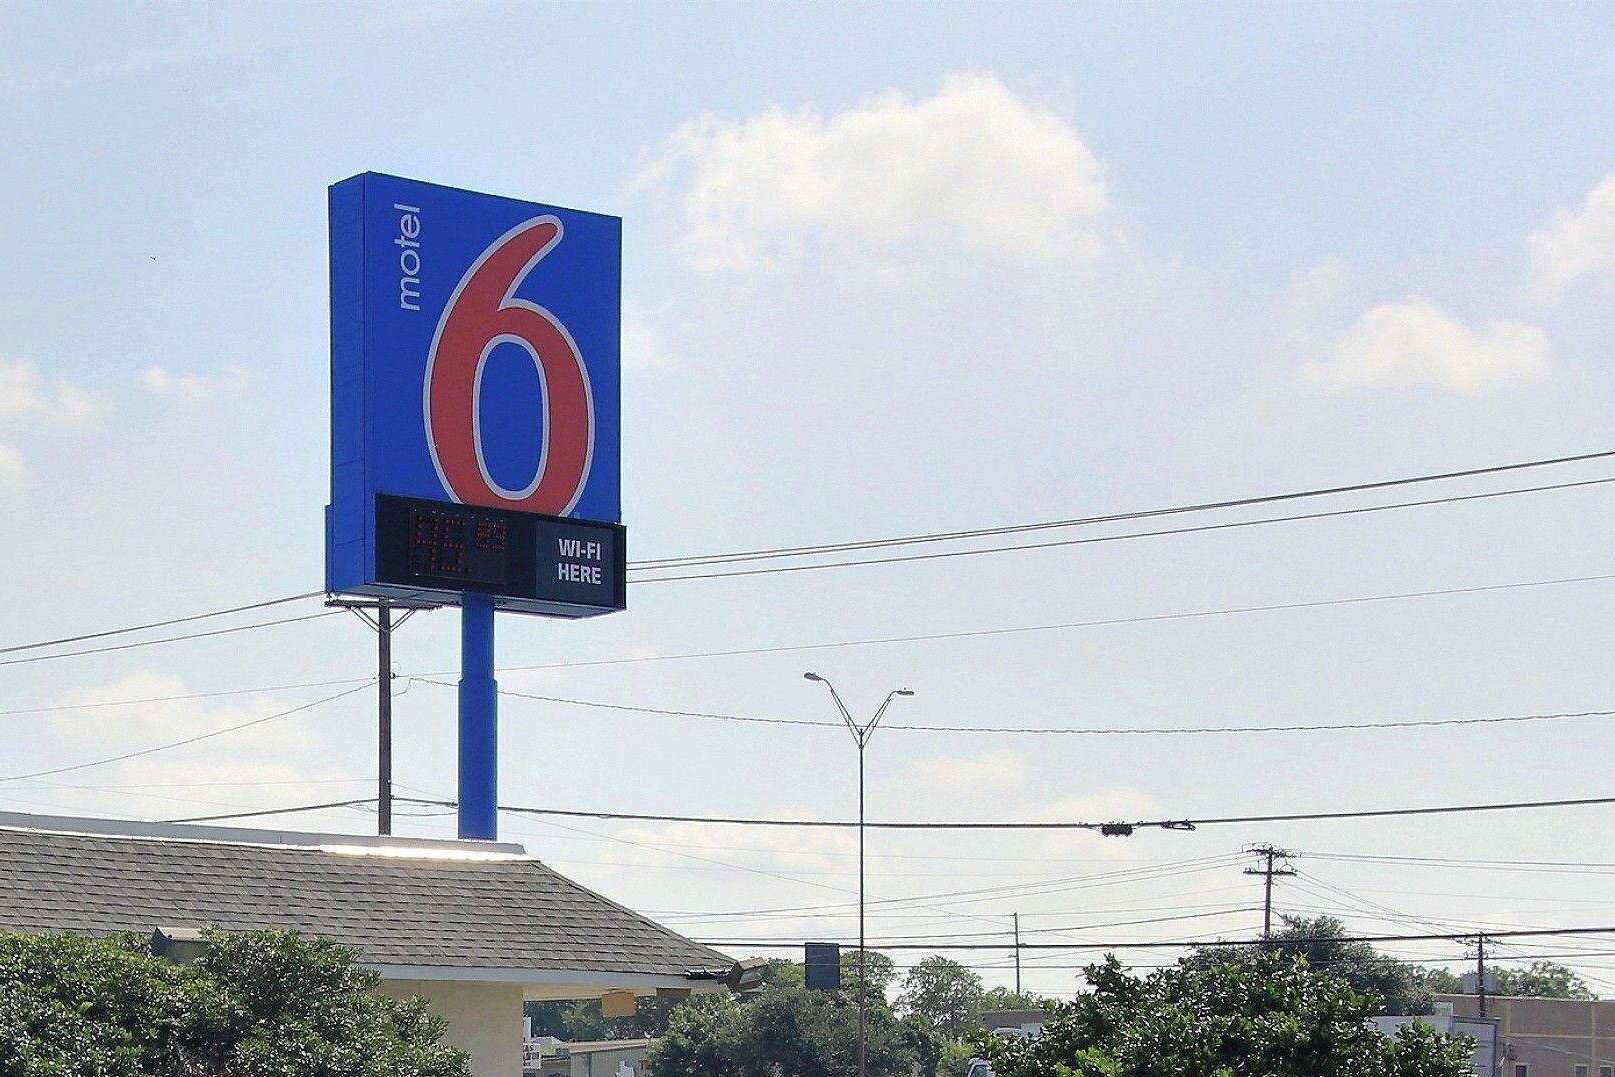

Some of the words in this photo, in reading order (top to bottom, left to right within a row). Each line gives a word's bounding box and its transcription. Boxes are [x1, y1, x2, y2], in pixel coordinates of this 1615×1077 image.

[393, 202, 421, 311] motel
[423, 214, 596, 517] 6
[557, 562, 602, 585] HERE
[558, 538, 602, 561] WI-FI
